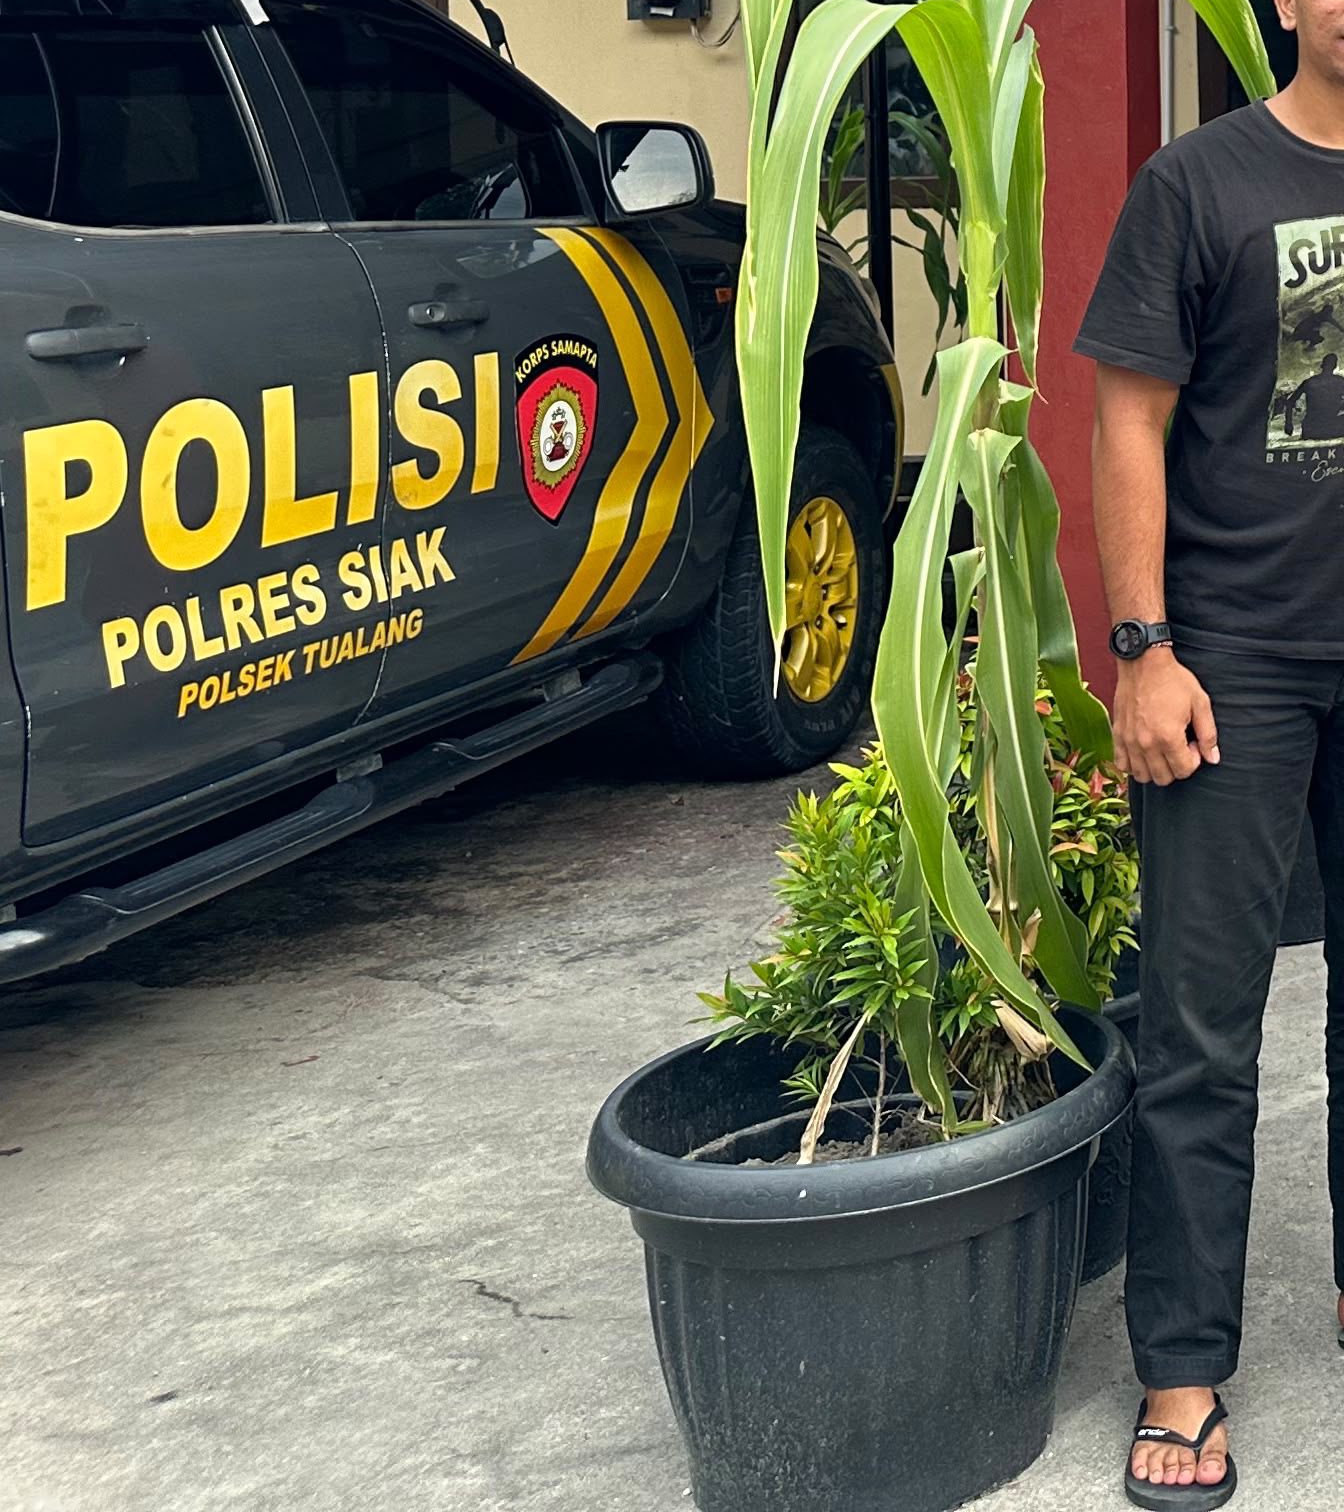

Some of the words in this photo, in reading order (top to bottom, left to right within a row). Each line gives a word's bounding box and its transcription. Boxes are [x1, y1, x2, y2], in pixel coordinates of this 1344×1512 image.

[515, 344, 550, 383] KORPS
[551, 340, 598, 369] SAMAPTA
[22, 351, 500, 612] POLISI
[102, 562, 328, 689] POLRES
[339, 526, 457, 605] SIAK
[177, 656, 296, 719] POLSEK
[303, 608, 424, 675] TUALANG
